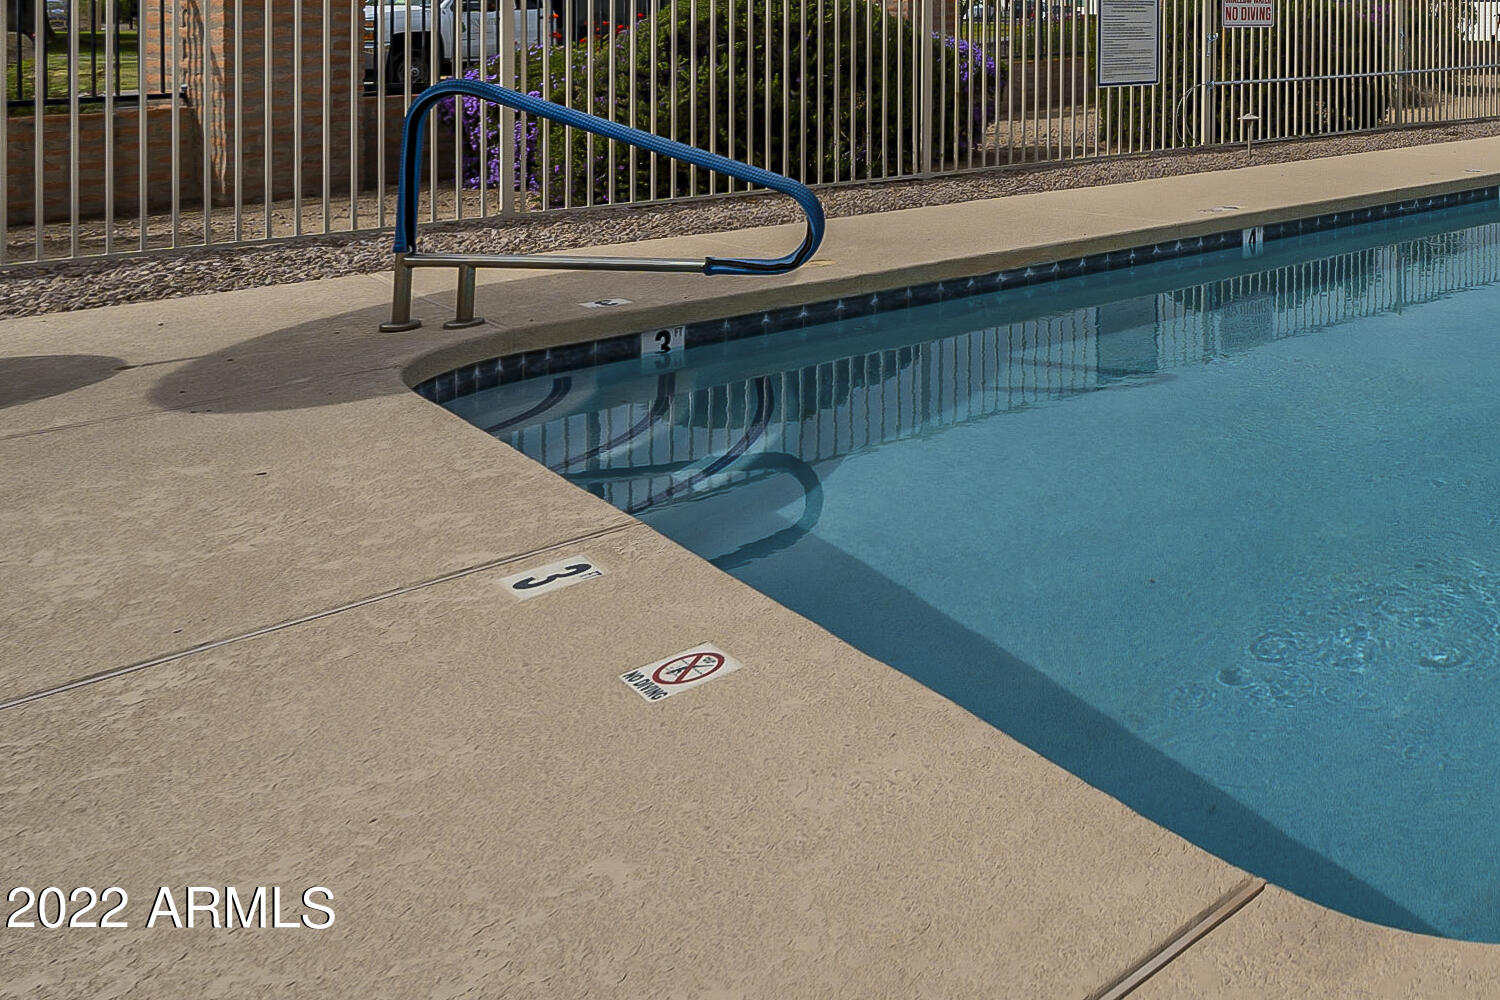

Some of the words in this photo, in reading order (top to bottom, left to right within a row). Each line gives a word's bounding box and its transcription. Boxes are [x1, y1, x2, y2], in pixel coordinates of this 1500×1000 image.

[1225, 6, 1239, 21] NO
[1241, 6, 1271, 21] DIVING
[512, 563, 592, 590] 3
[622, 670, 645, 682] NO
[633, 678, 668, 700] DIVING
